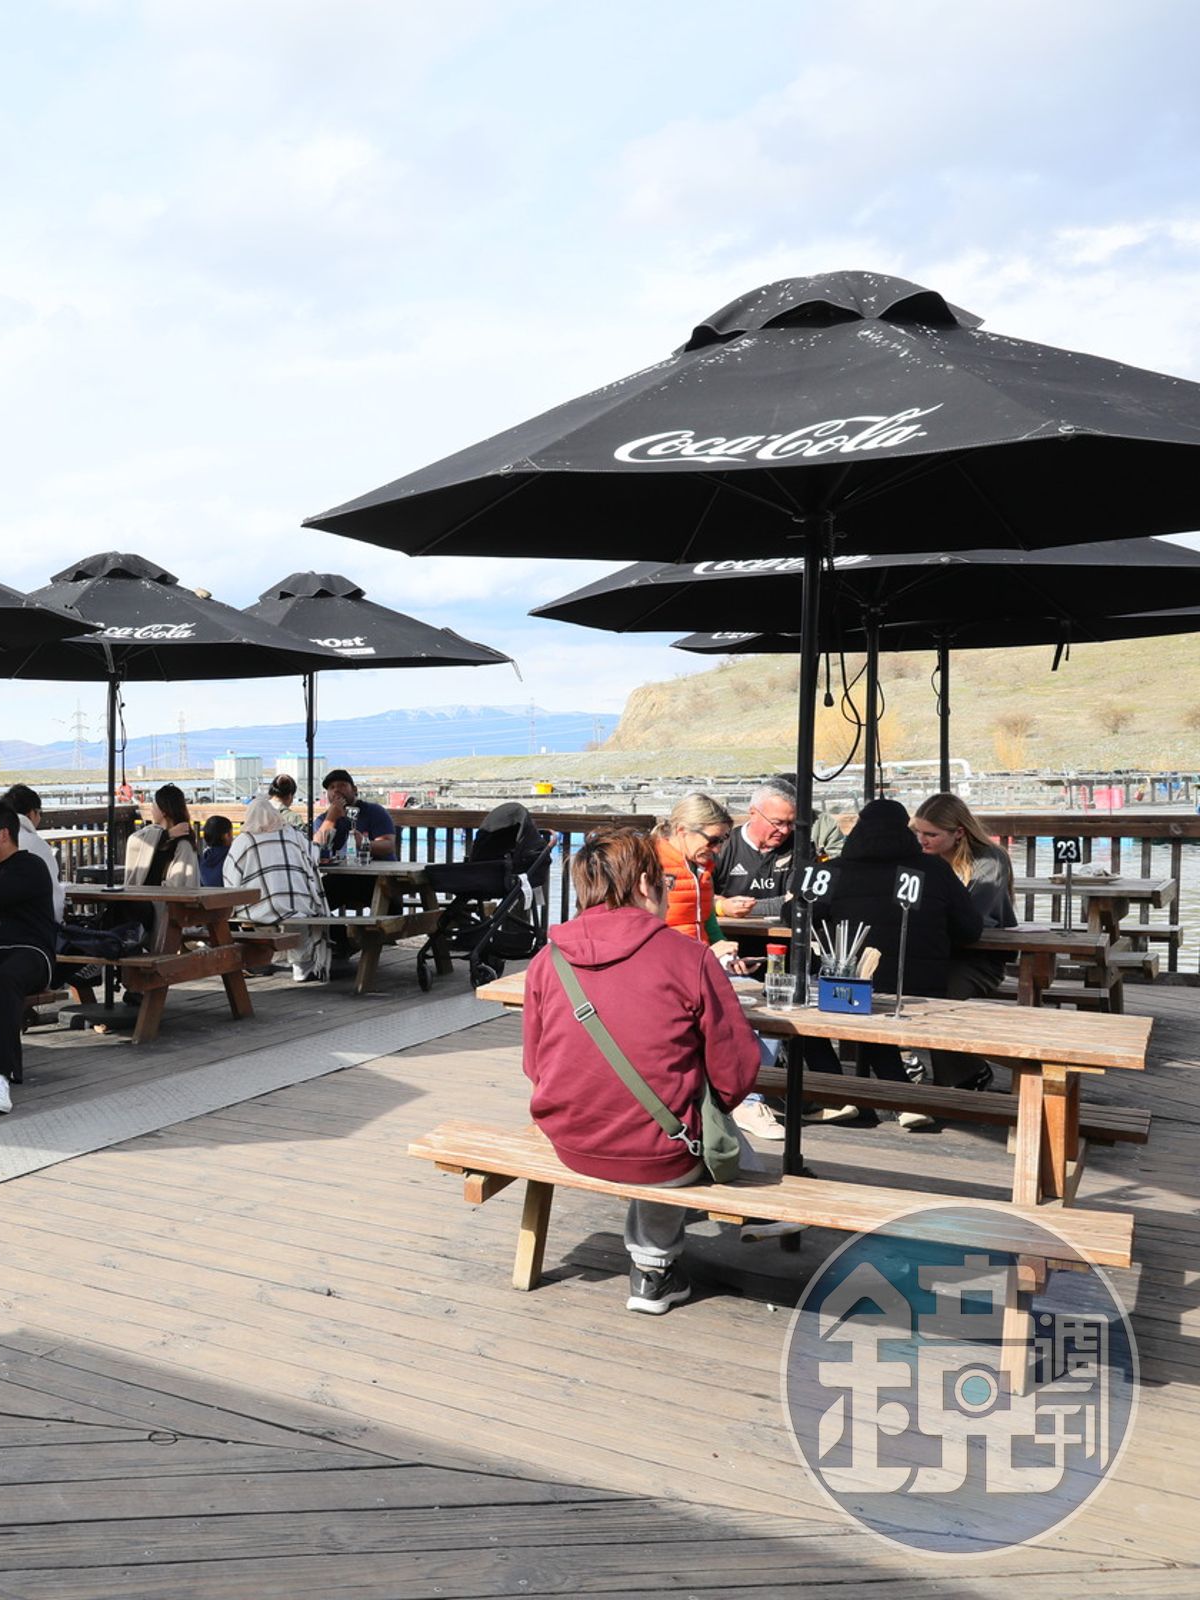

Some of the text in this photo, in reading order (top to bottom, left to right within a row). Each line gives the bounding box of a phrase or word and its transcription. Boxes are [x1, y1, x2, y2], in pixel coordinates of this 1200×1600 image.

[614, 402, 944, 463] Coca-Cola
[1056, 840, 1078, 859] 23
[749, 878, 776, 890] AIG
[801, 866, 831, 896] 18
[896, 872, 921, 903] 20
